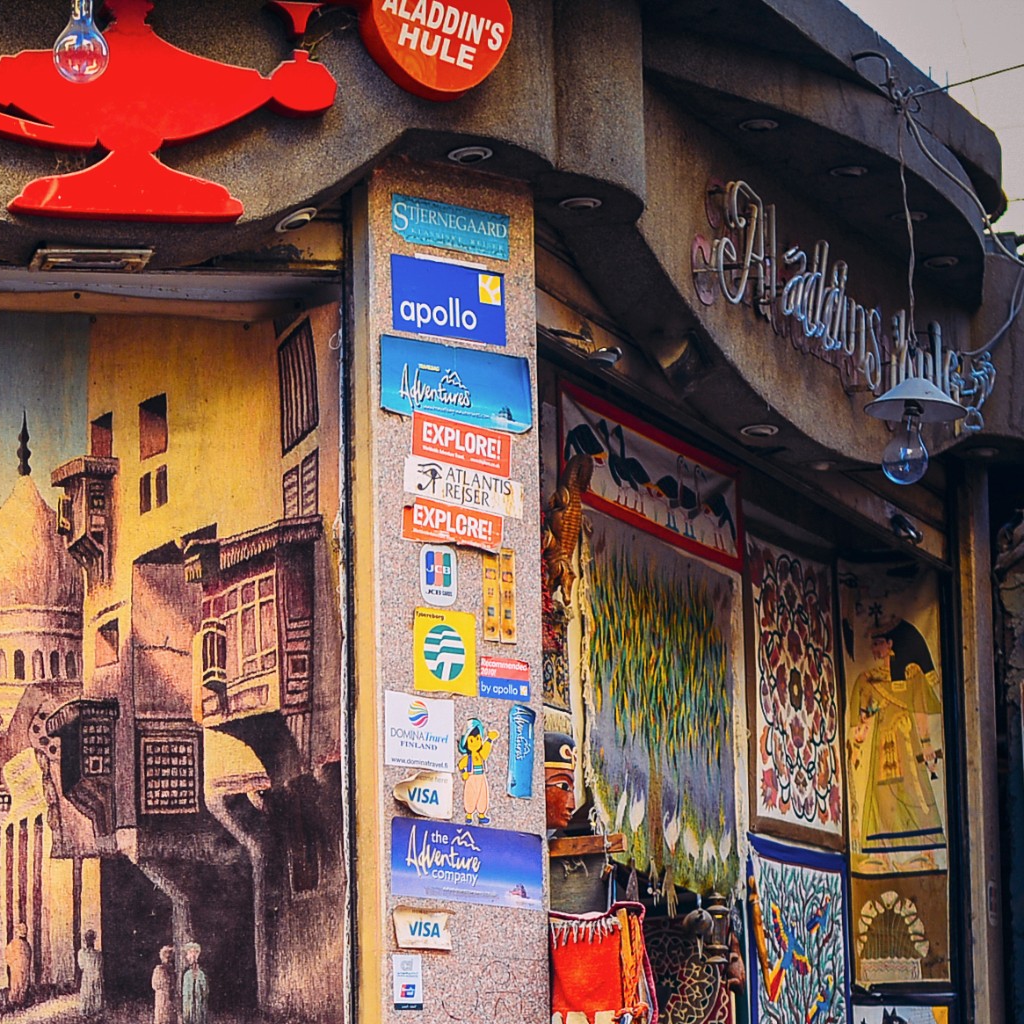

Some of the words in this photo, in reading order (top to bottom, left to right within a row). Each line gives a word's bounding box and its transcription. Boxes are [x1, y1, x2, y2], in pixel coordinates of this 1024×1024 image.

[397, 23, 476, 70] HULE
[393, 202, 507, 238] STJERNEGAARD
[400, 297, 477, 330] apollo
[399, 363, 471, 408] Adventures
[422, 421, 501, 460] EXPLORE!
[446, 467, 511, 495] ATLANTIS
[446, 482, 490, 507] REJSER
[413, 503, 493, 542] EXPLORE!
[426, 564, 451, 575] JCB
[481, 681, 491, 694] by
[492, 684, 518, 695] apollo
[400, 740, 438, 751] FINLAND
[408, 786, 440, 806] VISA
[431, 830, 449, 845] the
[405, 825, 481, 877] Adventure
[431, 869, 478, 887] company
[409, 921, 441, 938] VISA
